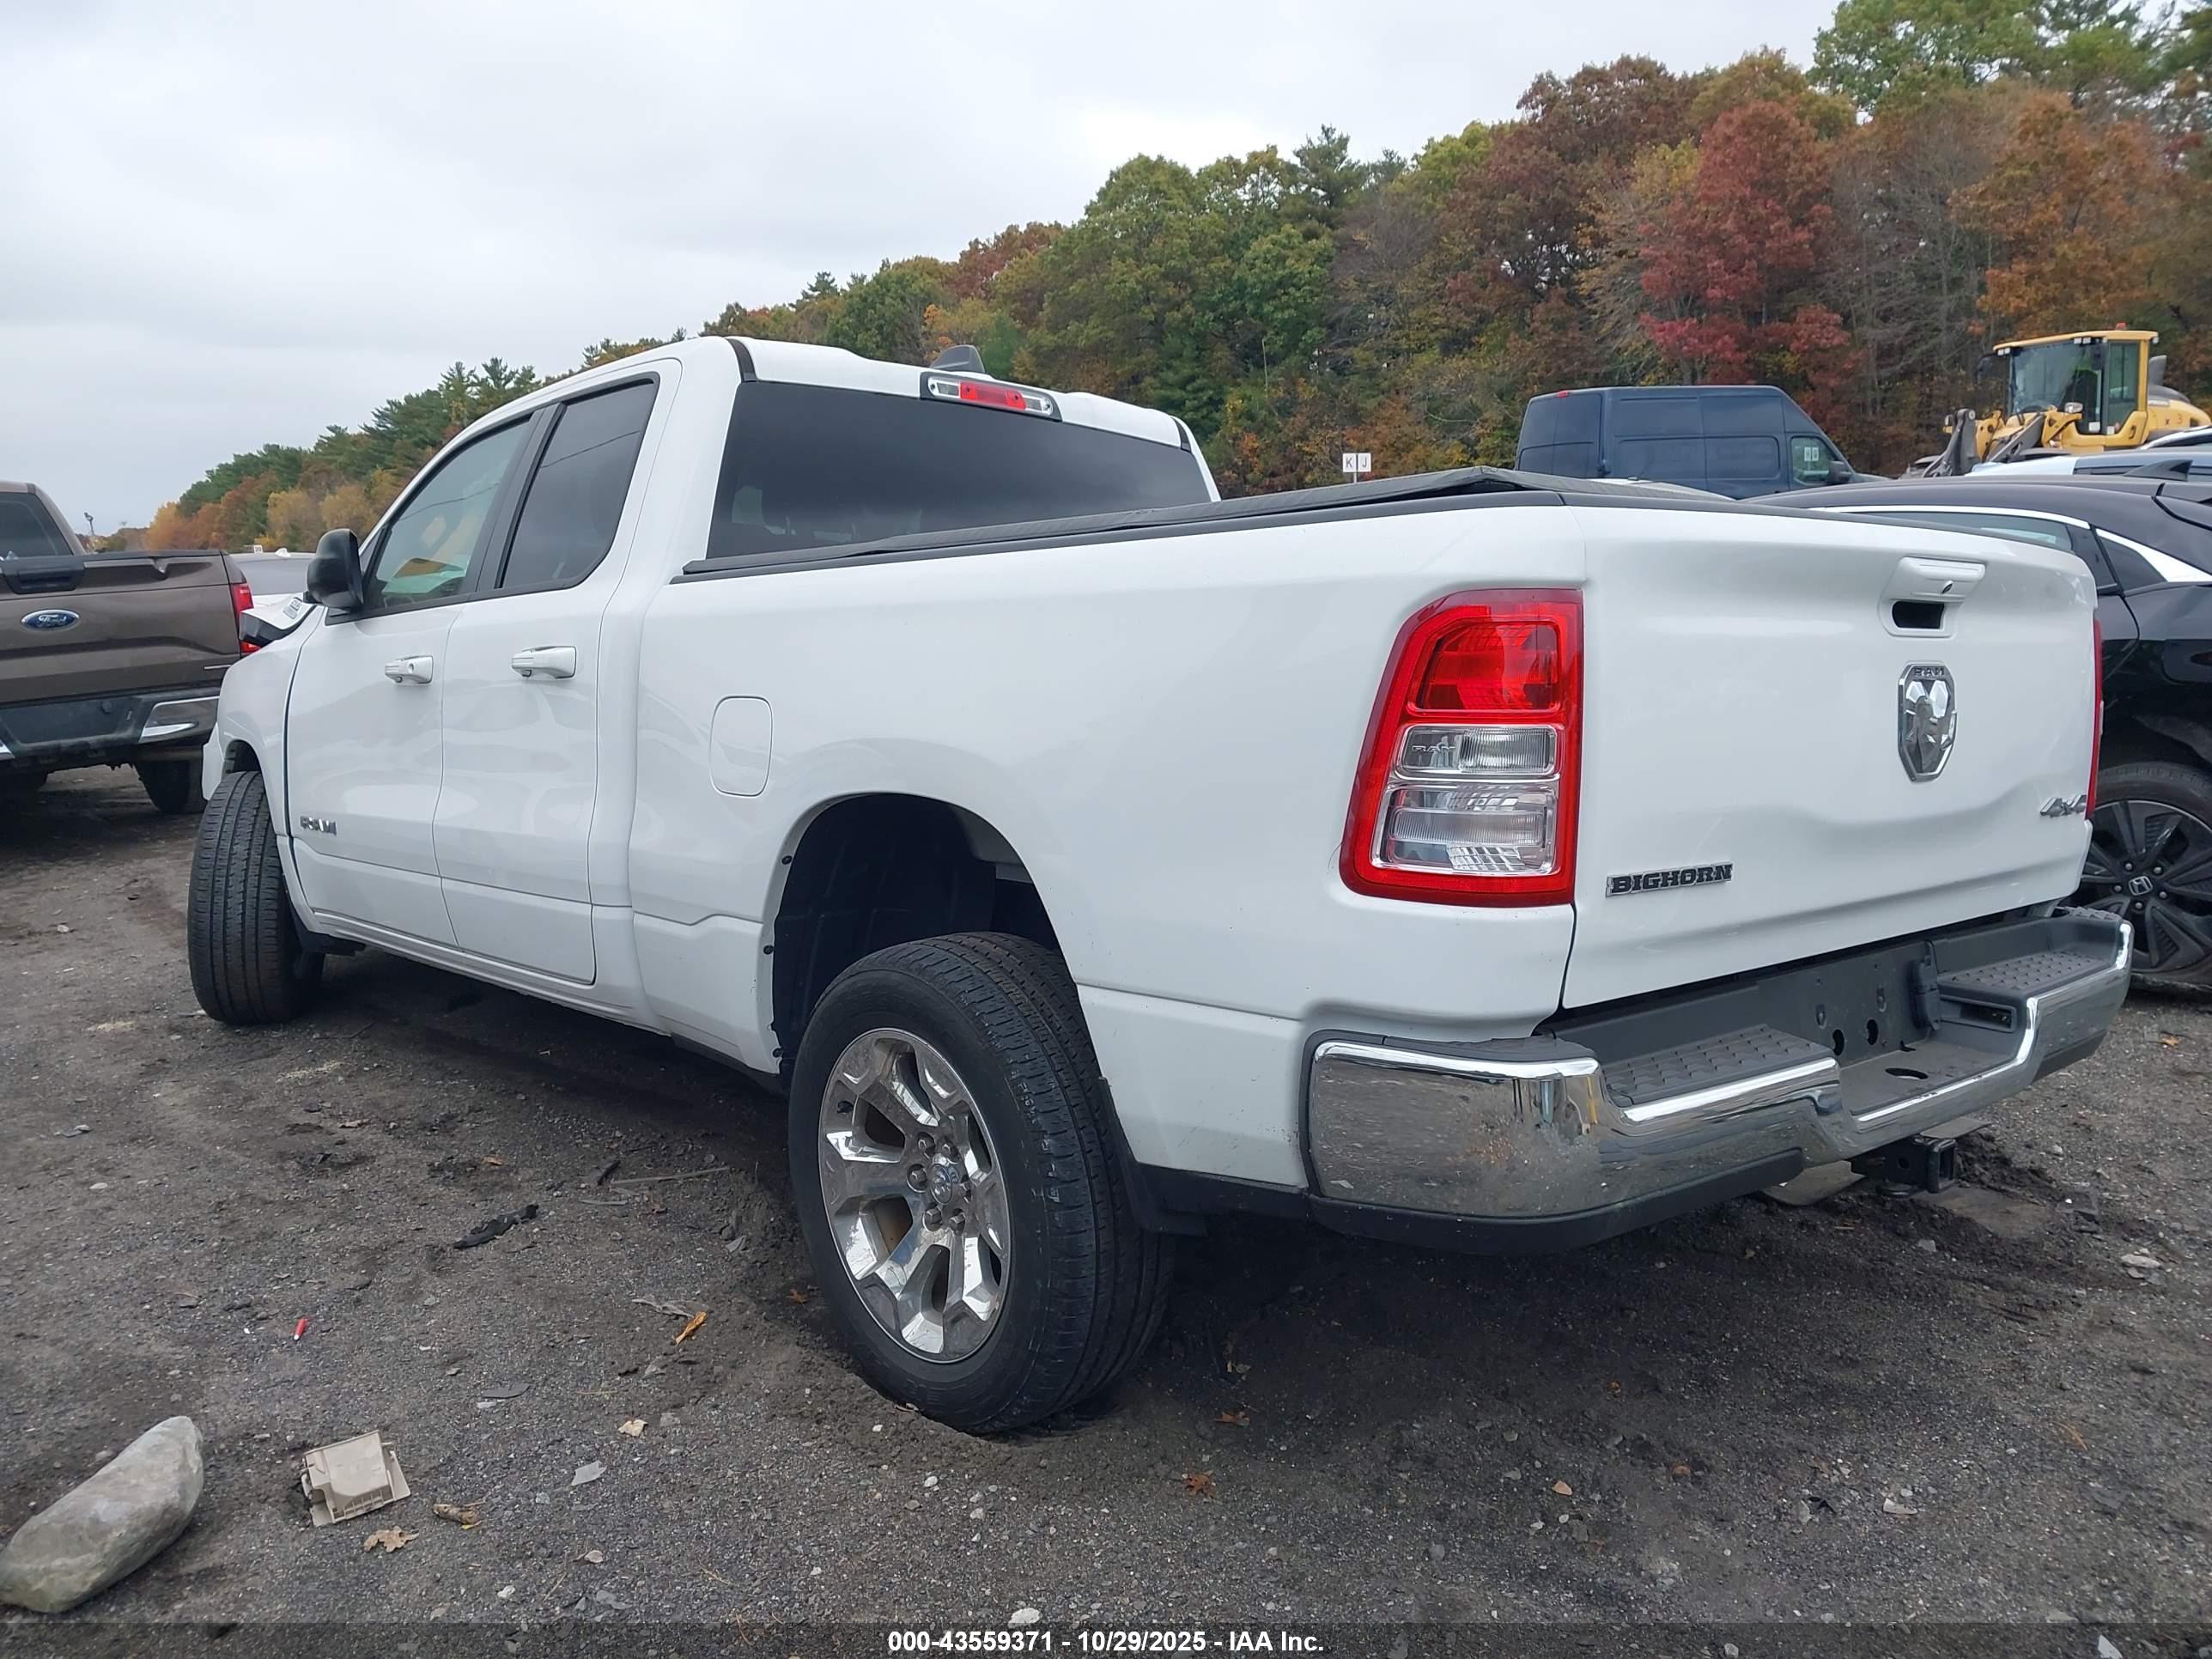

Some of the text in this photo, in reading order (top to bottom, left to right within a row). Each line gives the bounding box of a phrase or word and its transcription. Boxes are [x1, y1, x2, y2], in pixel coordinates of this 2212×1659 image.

[1346, 457, 1367, 468] K J
[38, 613, 68, 628] Ford
[1914, 667, 1945, 678] RAM
[1606, 861, 1733, 897] BIGHORN
